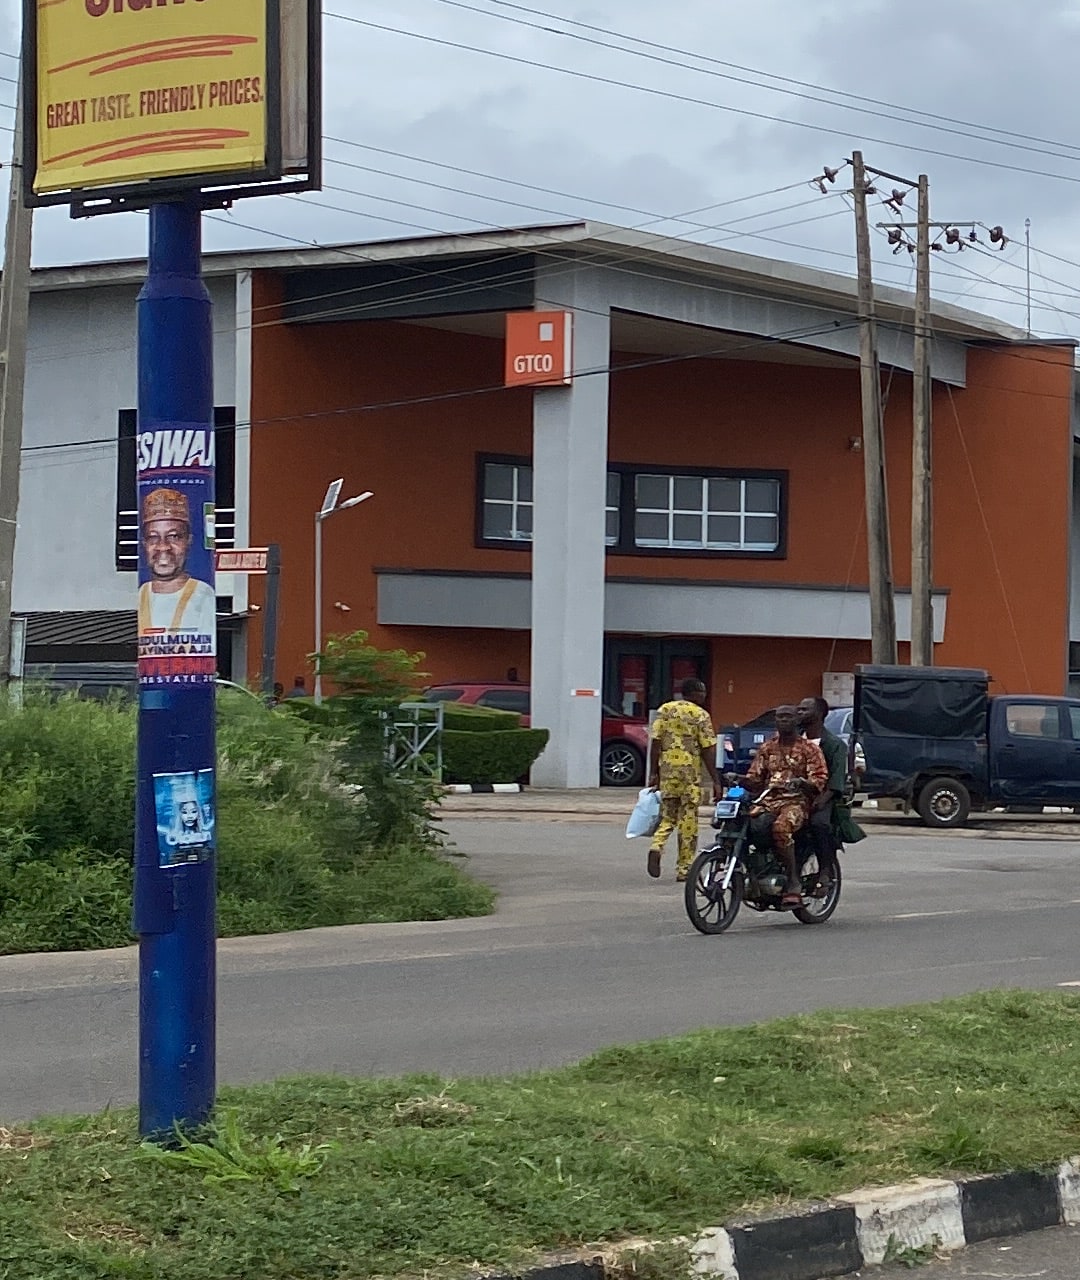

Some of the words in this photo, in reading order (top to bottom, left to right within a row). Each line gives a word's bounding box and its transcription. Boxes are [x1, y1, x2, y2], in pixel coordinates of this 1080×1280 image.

[46, 99, 87, 129] GREAT
[90, 93, 135, 123] TASTE.
[139, 83, 206, 117] FRIENDLY
[209, 76, 264, 108] PRICES.
[513, 353, 553, 374] GTCO
